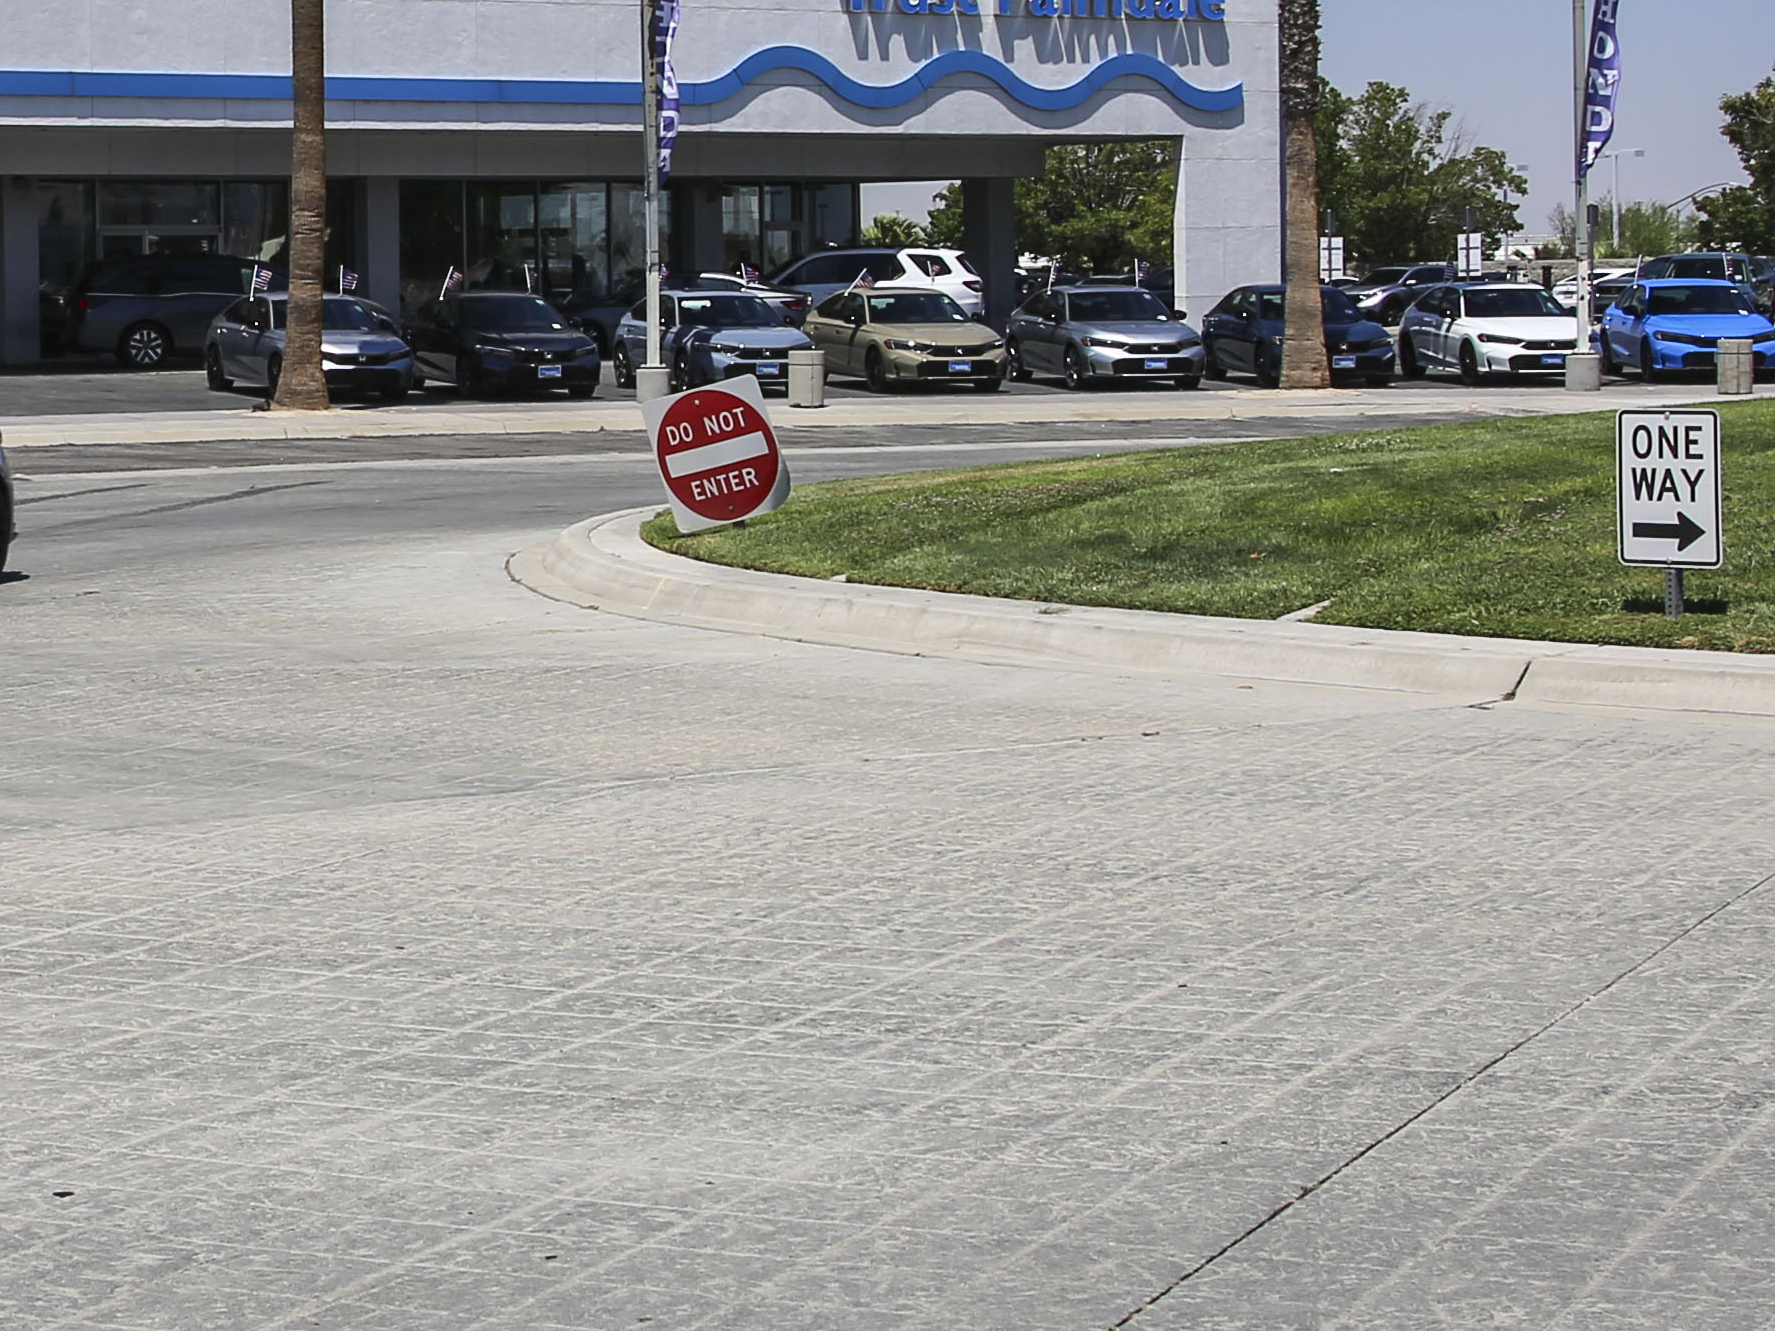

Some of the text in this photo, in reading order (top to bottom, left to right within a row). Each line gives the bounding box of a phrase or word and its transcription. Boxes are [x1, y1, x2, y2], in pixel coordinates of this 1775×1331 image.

[665, 407, 745, 446] DO NOT
[1632, 424, 1703, 459] ONE
[690, 467, 759, 501] ENTER
[1631, 467, 1705, 502] WAY
